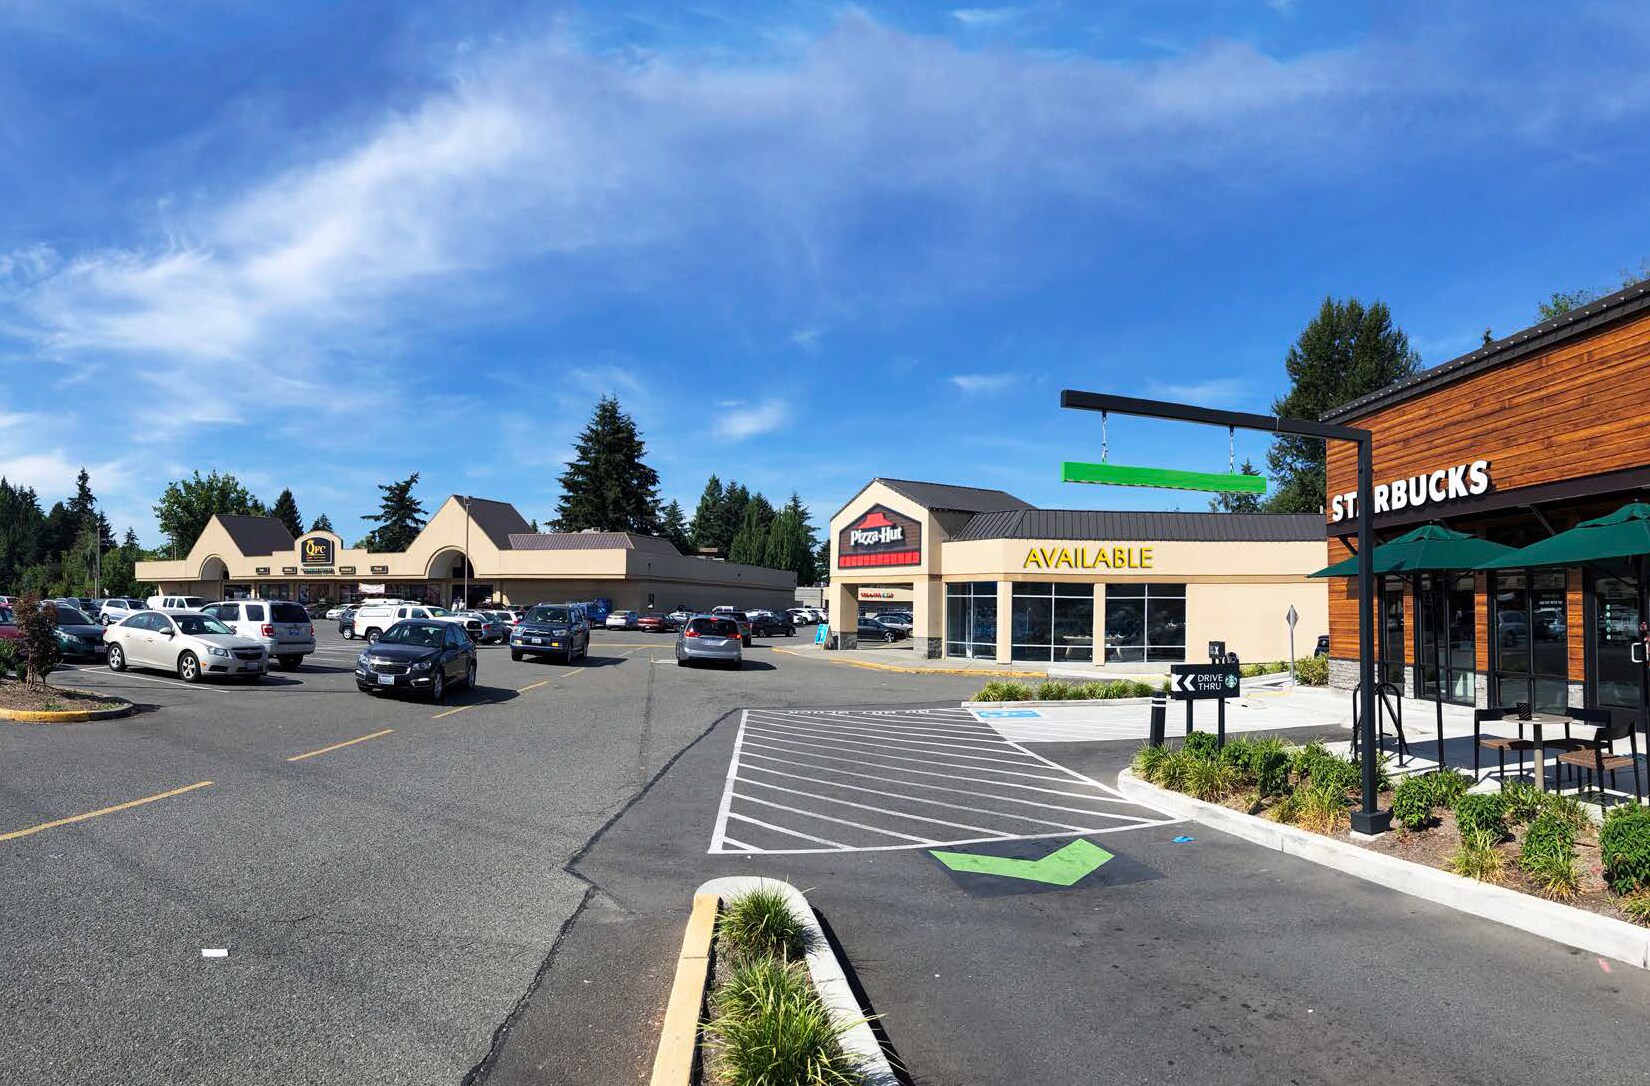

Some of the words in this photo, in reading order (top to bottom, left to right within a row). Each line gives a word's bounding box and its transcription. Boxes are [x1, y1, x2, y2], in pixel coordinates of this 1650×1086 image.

[1332, 460, 1488, 522] STRBUCKS
[305, 540, 326, 556] QFC
[1023, 547, 1154, 569] AVAILABLE
[1197, 673, 1223, 682] DRIVE
[1198, 682, 1222, 690] THRU
